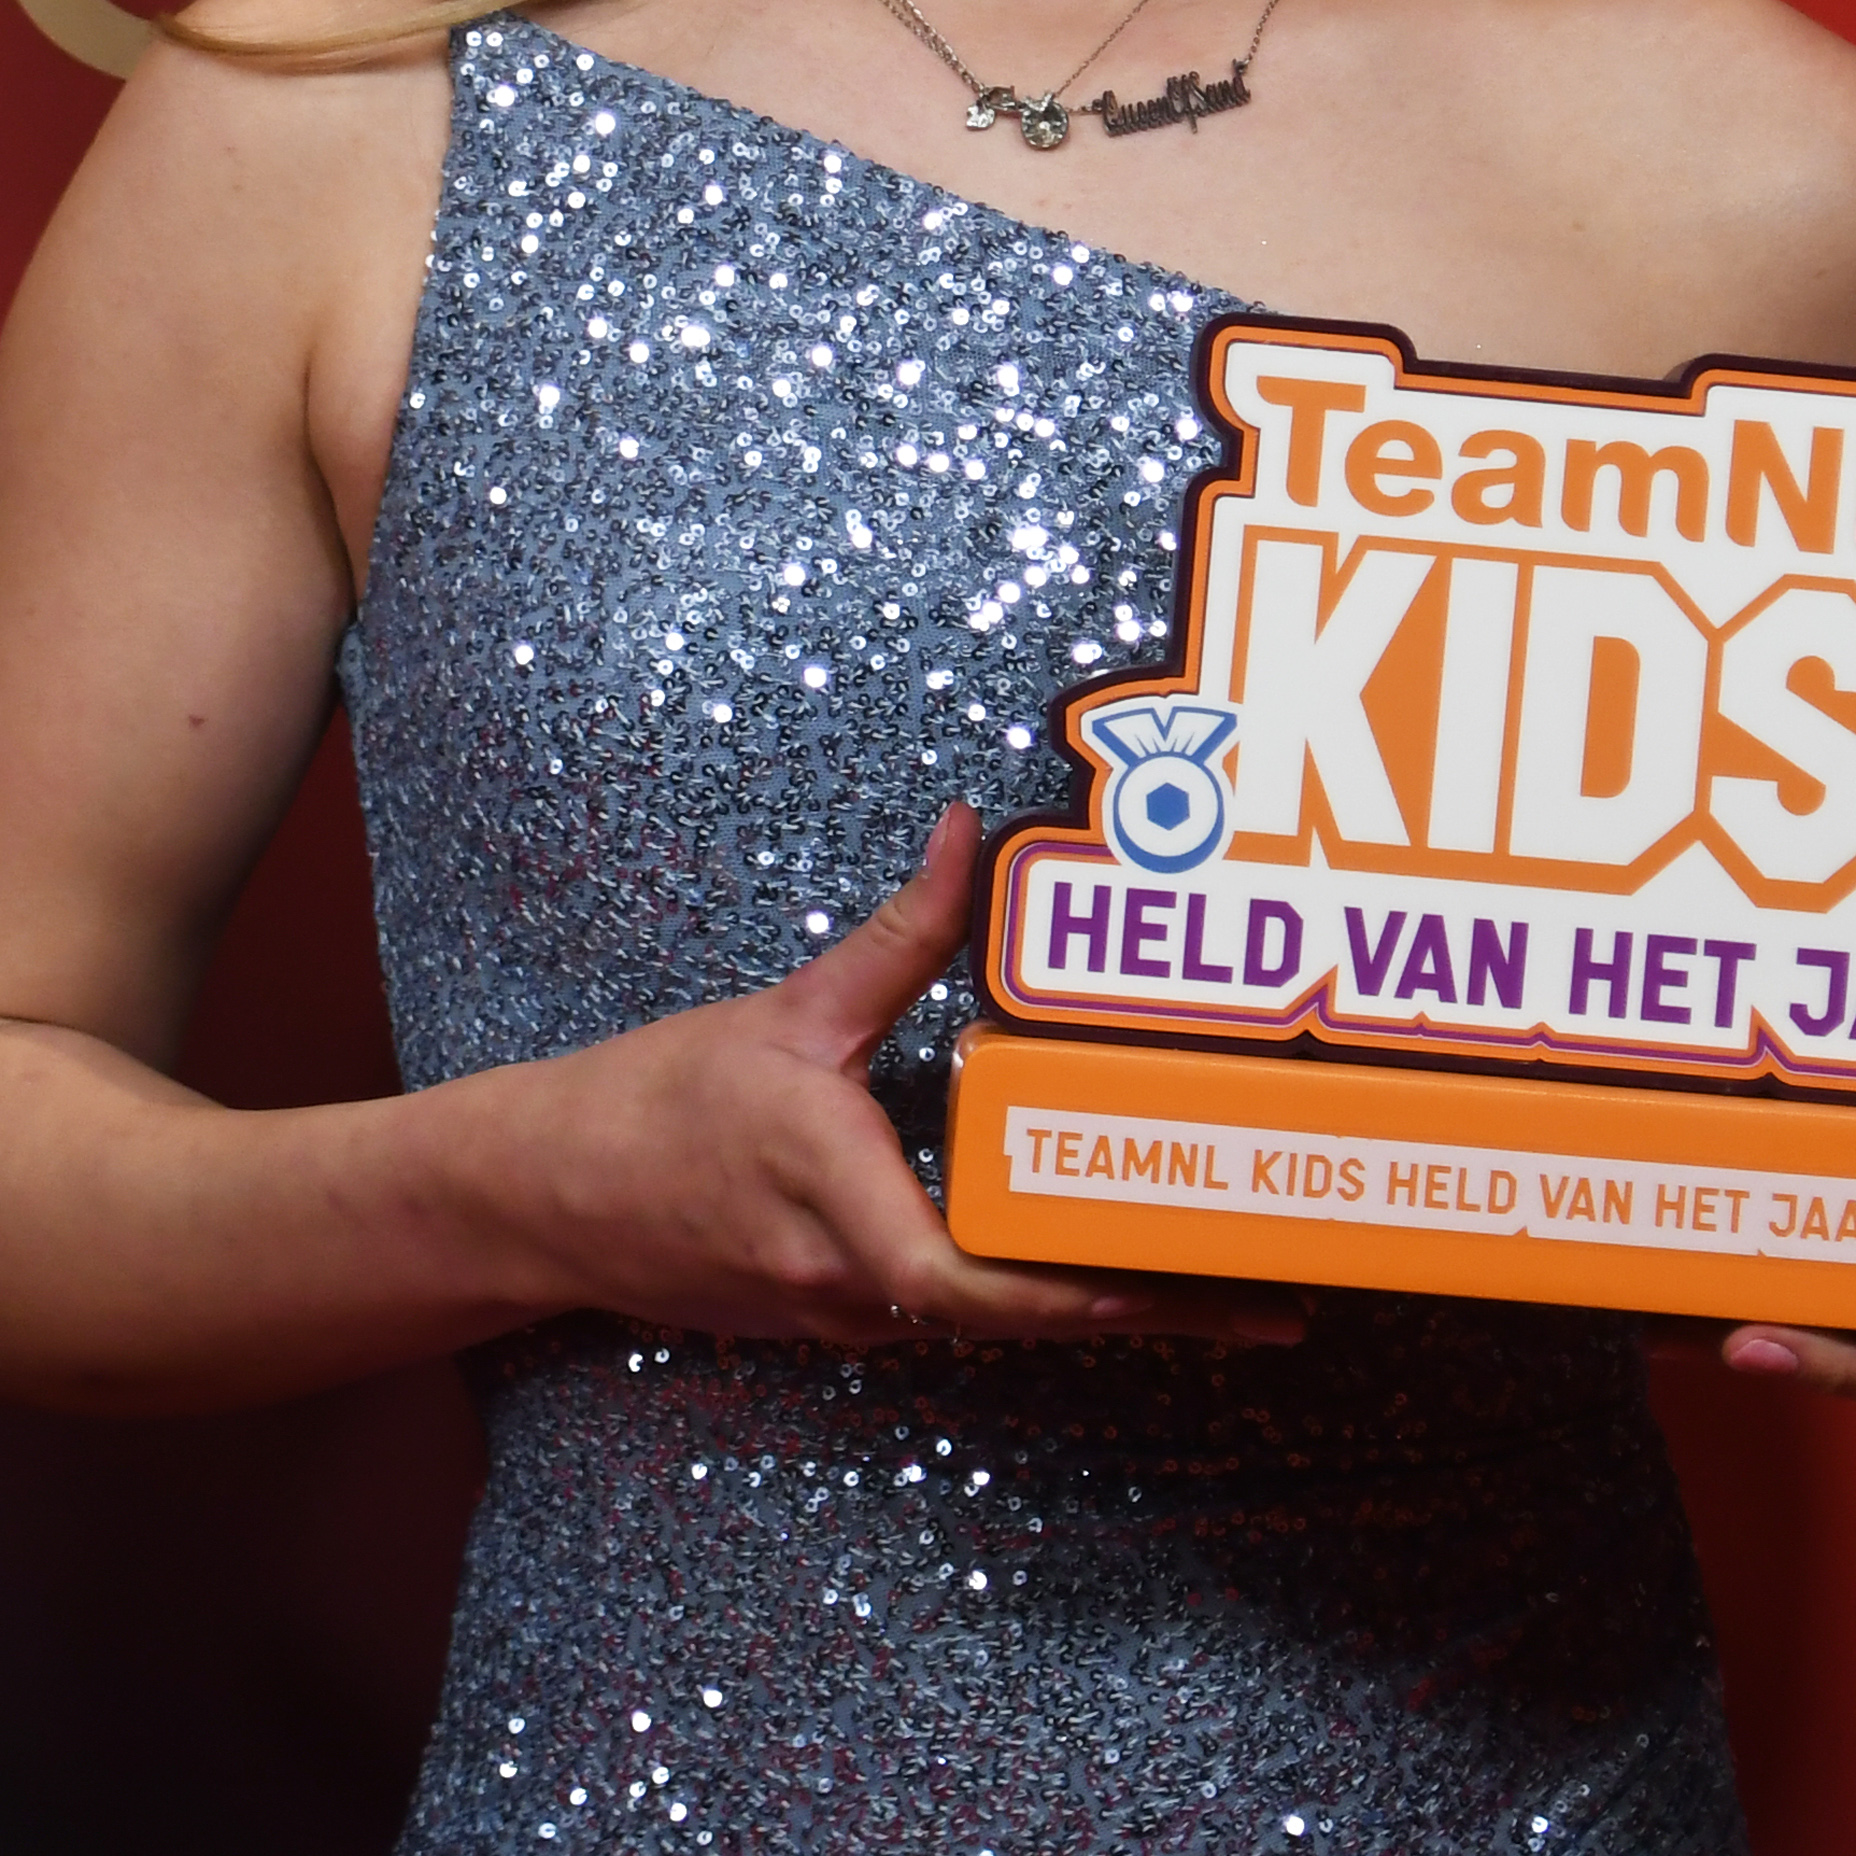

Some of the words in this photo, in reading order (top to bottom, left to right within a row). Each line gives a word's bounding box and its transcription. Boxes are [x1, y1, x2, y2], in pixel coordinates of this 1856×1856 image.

[1048, 881, 1303, 987] HELD
[1345, 907, 1530, 1009] VAN
[1568, 928, 1756, 1028] HET
[1026, 1128, 1229, 1190] TEAMNL
[1251, 1149, 1366, 1201] KIDS
[1386, 1161, 1518, 1215] HELD
[1539, 1173, 1633, 1225] VAN
[1655, 1183, 1750, 1233] HET
